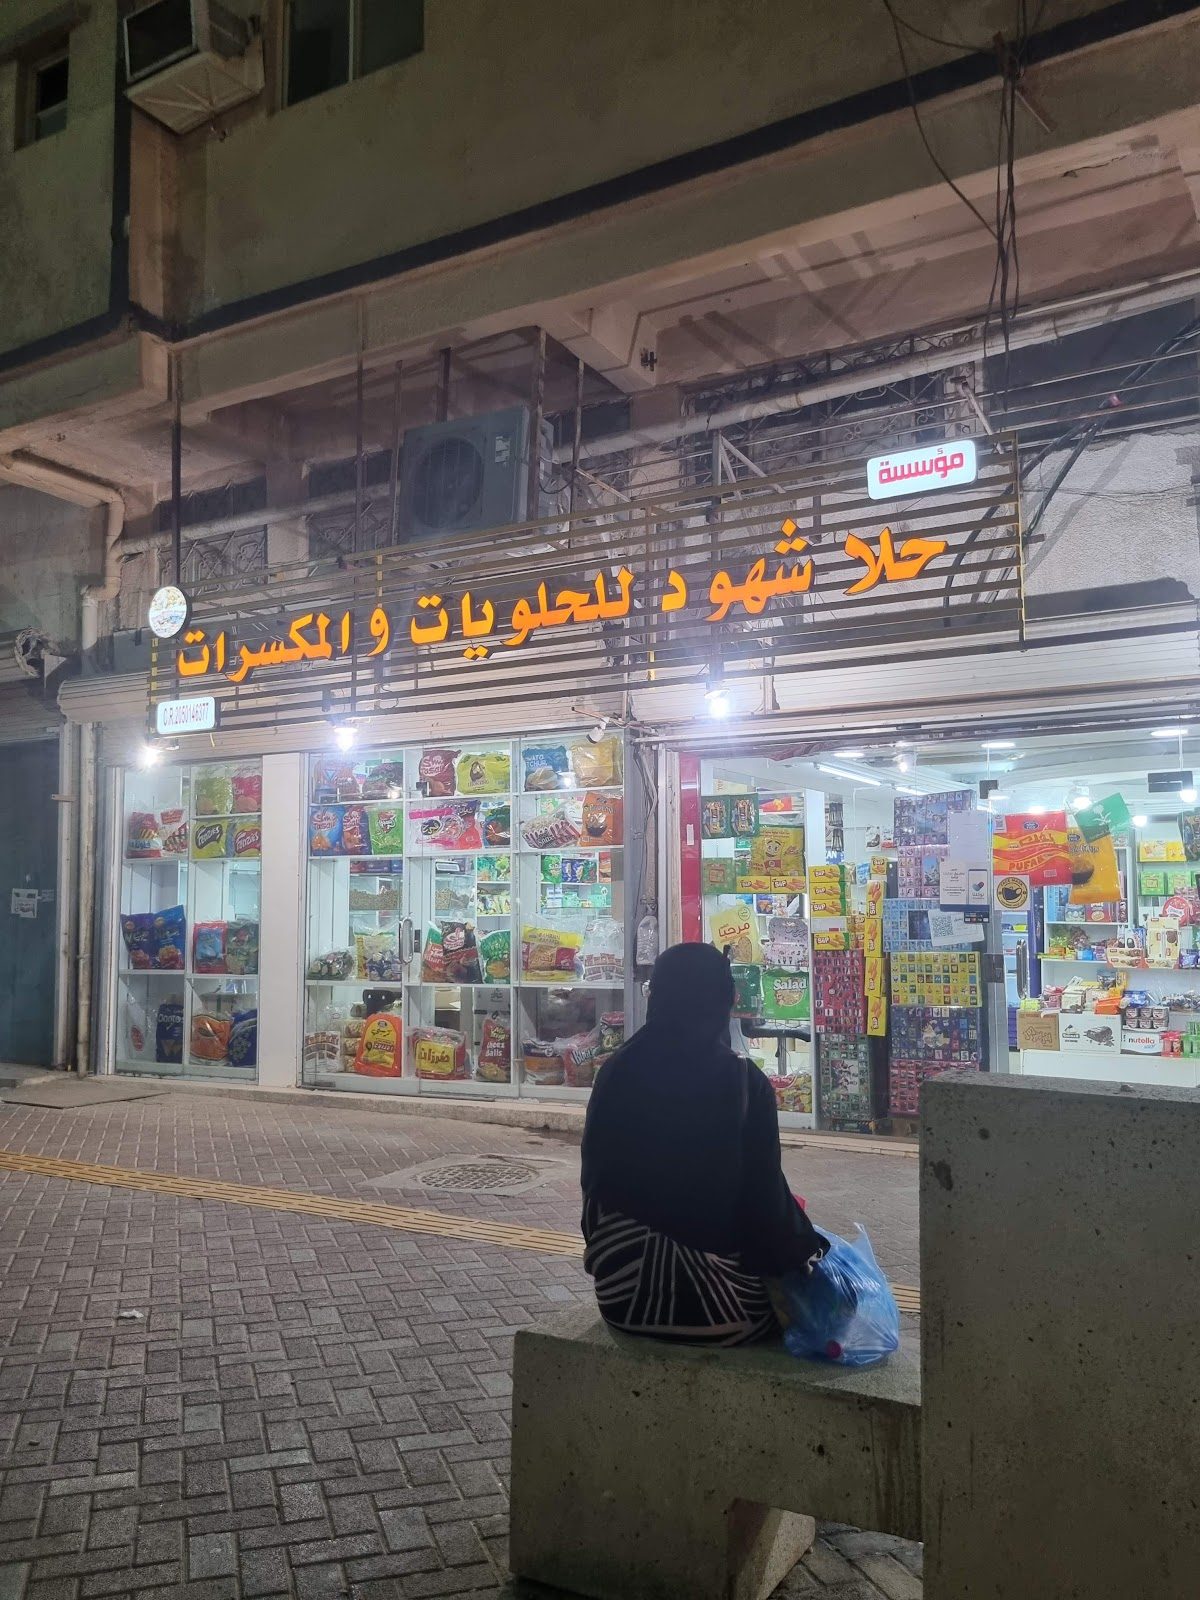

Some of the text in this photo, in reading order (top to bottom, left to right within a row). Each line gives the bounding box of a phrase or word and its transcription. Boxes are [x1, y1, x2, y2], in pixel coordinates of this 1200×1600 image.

[878, 447, 964, 485] مؤسسة
[843, 527, 949, 596] حلا
[177, 613, 351, 682] المكسرات
[370, 607, 390, 654] و
[718, 922, 750, 939] مرحبا
[773, 977, 808, 991] Salad
[1128, 1037, 1155, 1045] nutella
